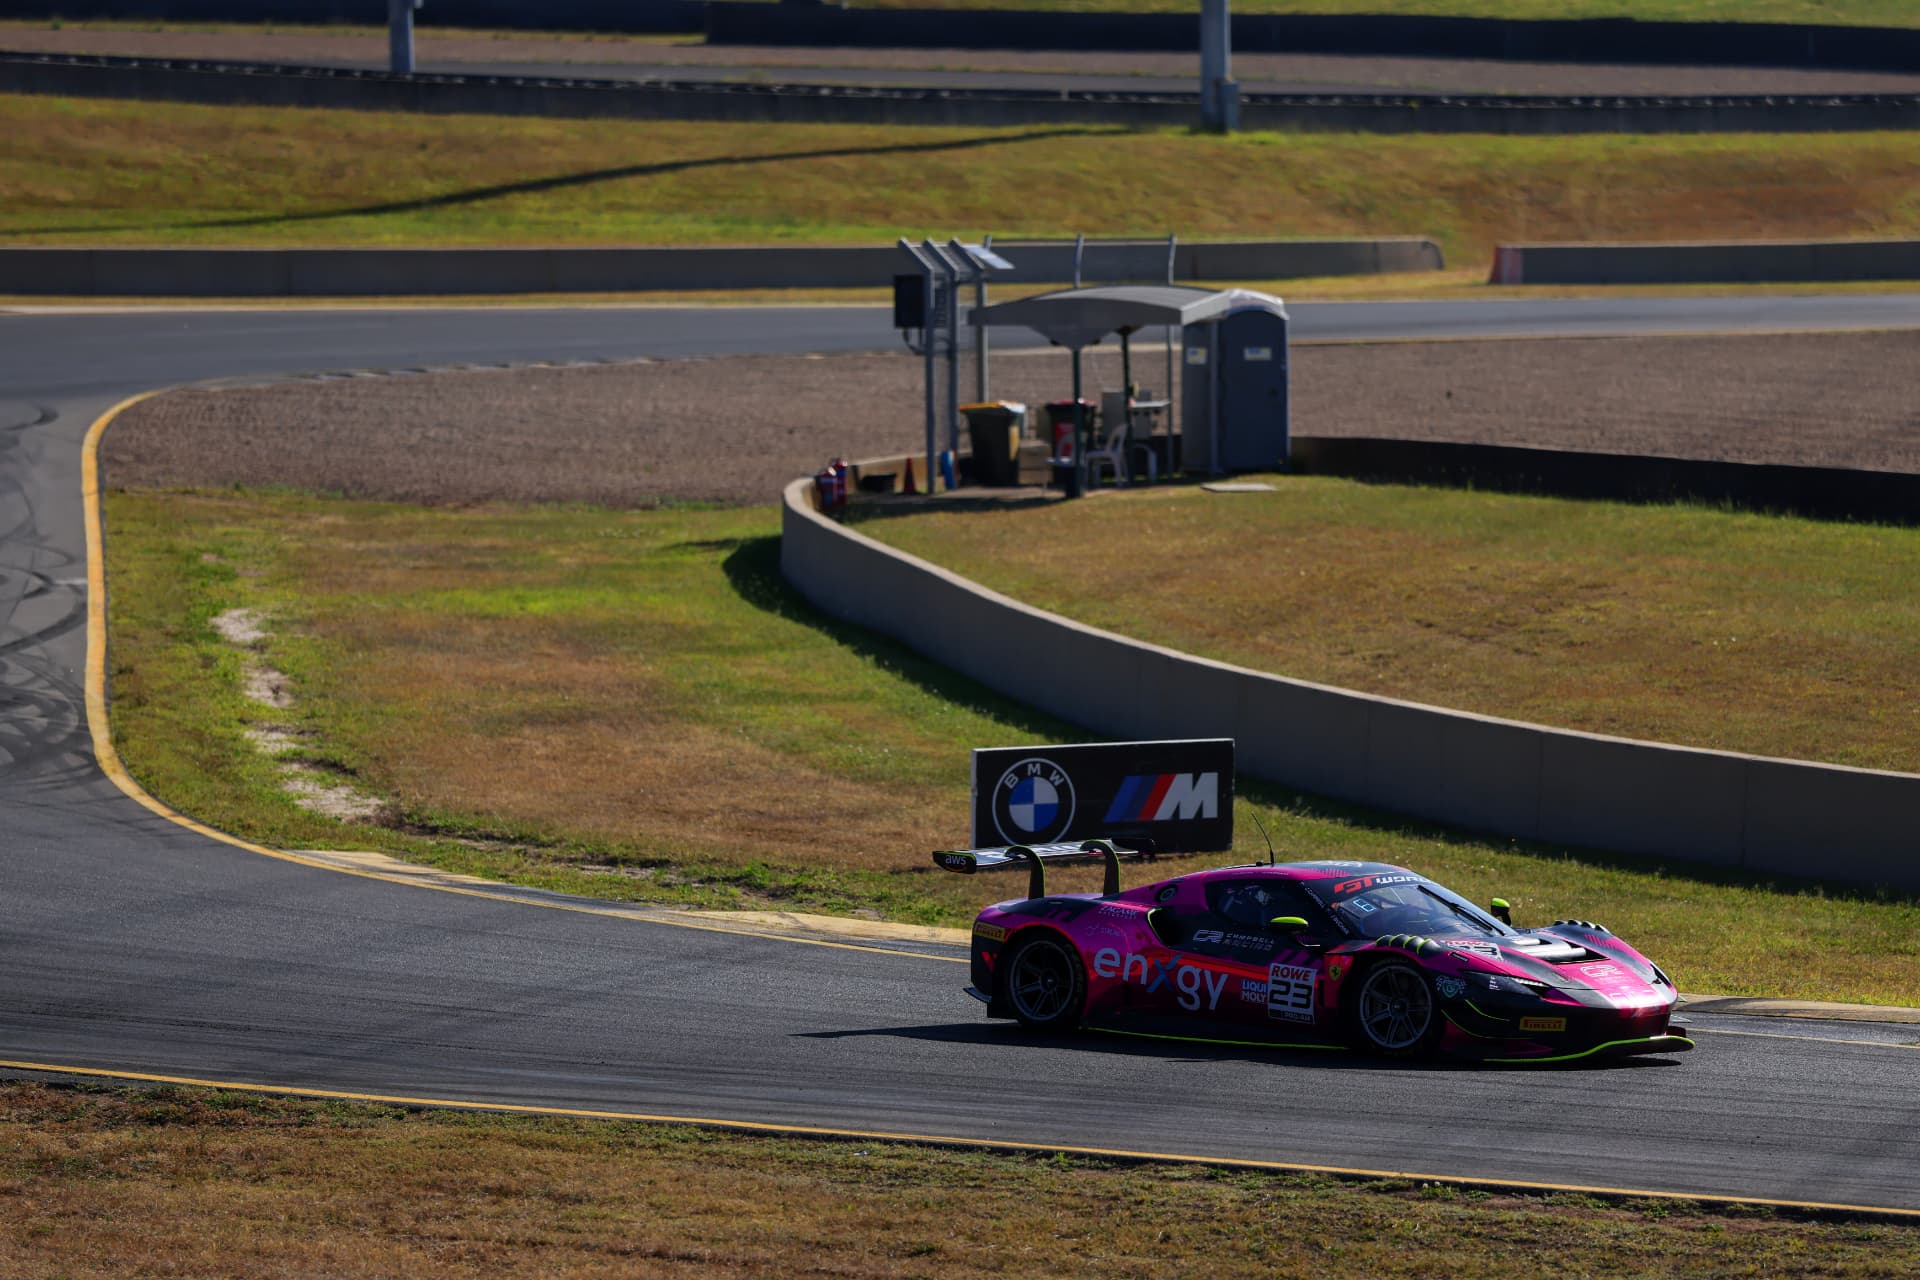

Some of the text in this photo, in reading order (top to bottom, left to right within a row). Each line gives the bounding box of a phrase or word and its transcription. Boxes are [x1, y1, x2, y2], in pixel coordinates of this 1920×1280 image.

[1004, 762, 1065, 790] BMW
[1152, 772, 1219, 821] M
[944, 854, 967, 865] aws
[1333, 875, 1380, 894] GT
[1271, 965, 1312, 981] ROWE
[1242, 979, 1267, 993] LIQUI
[1241, 991, 1267, 1003] MOLY
[1269, 980, 1312, 1010] 23
